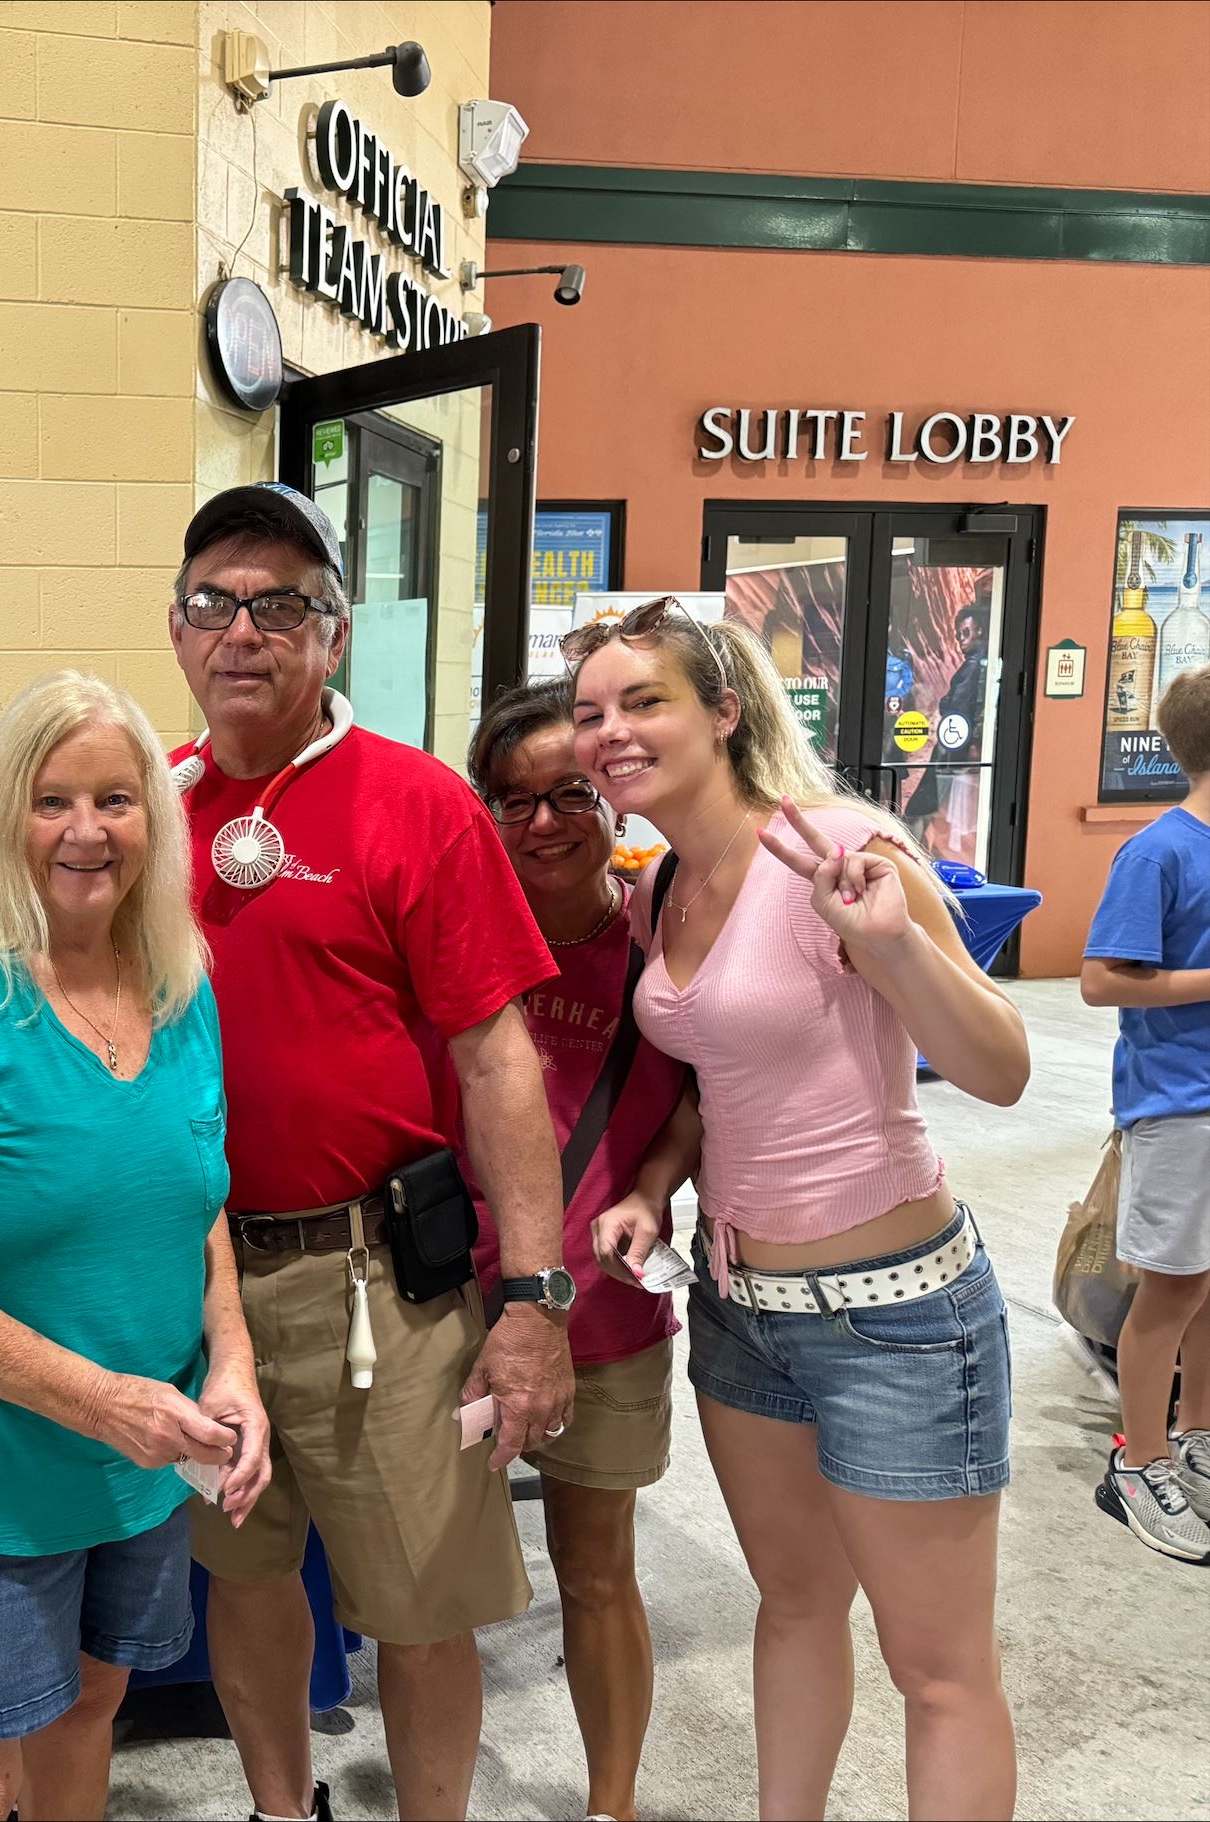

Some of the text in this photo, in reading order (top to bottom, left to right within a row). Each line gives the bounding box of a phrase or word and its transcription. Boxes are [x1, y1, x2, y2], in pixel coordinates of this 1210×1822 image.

[319, 100, 451, 277] OFFICIAL
[289, 187, 388, 336] TEAM
[700, 407, 1076, 464] SUITE LOBBY
[1122, 652, 1138, 660] BAY
[1176, 656, 1192, 664] BAY
[803, 677, 829, 689] OUR
[794, 694, 820, 705] USE
[1120, 736, 1162, 752] NINE
[292, 865, 341, 884] Beach
